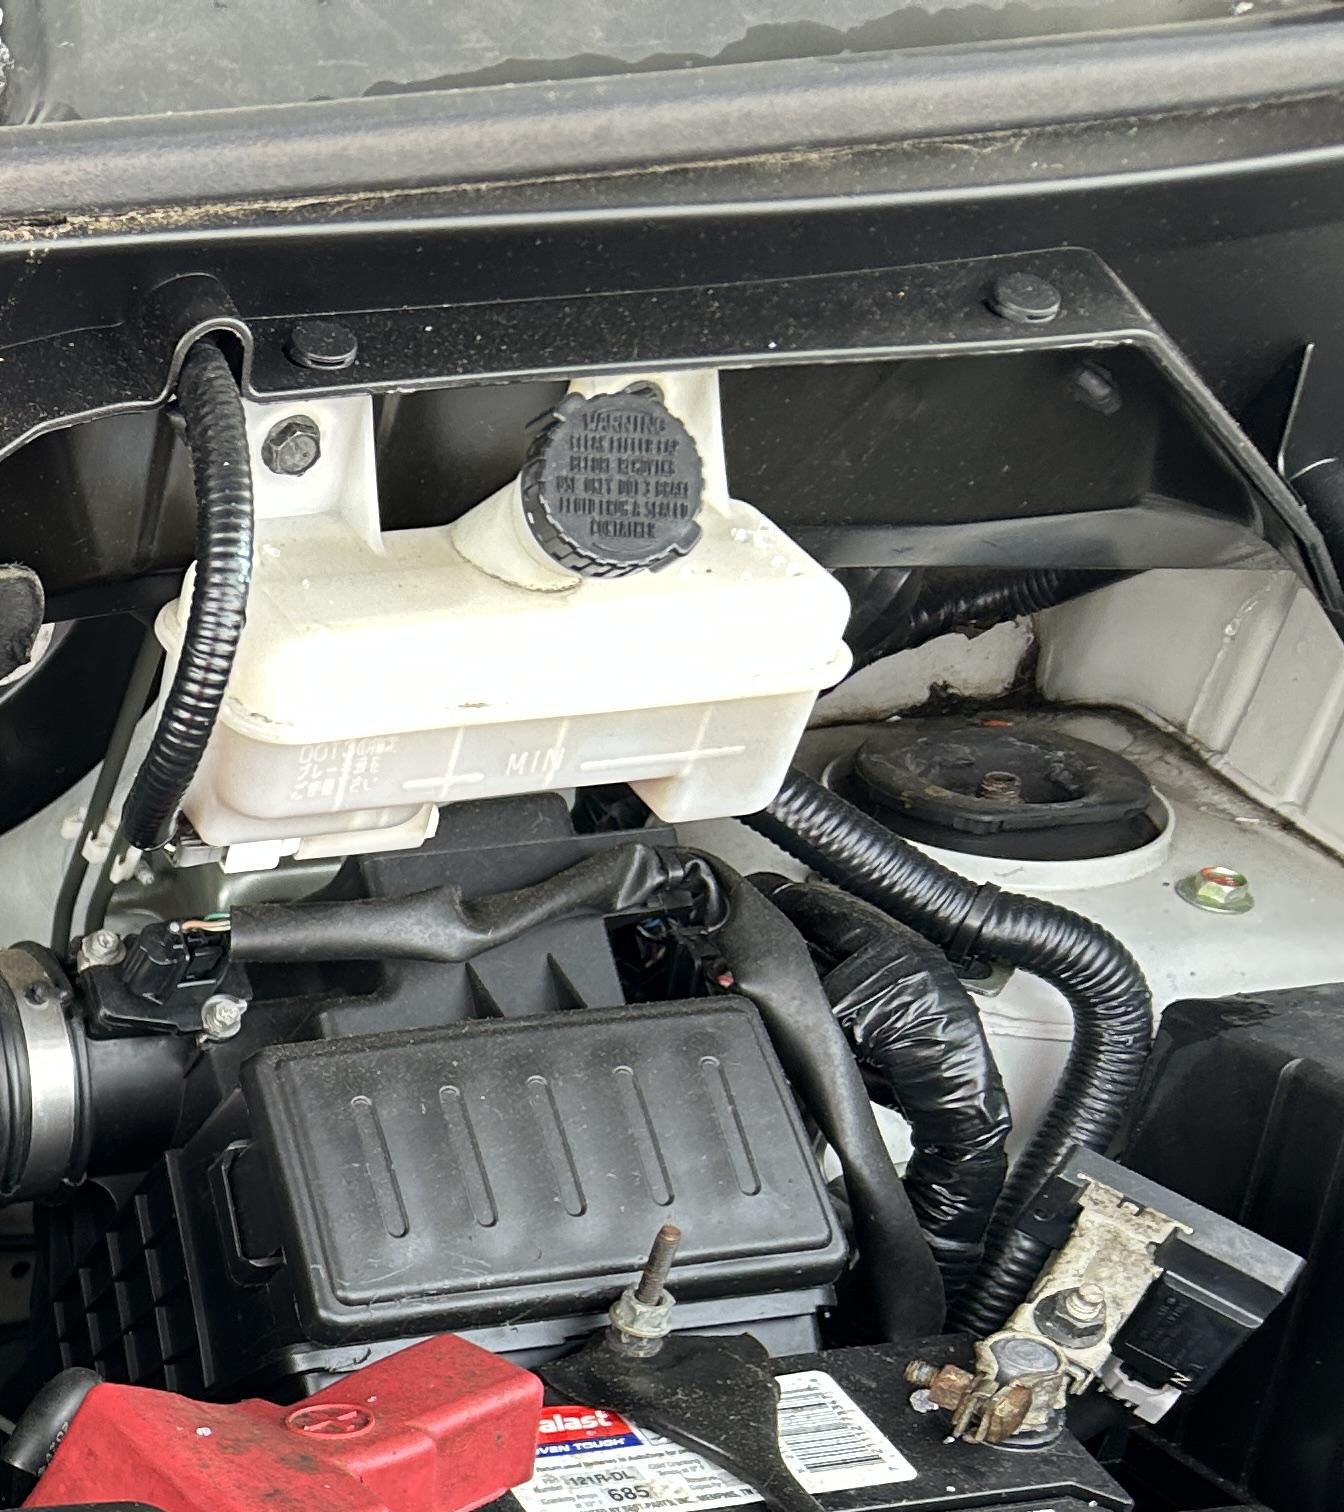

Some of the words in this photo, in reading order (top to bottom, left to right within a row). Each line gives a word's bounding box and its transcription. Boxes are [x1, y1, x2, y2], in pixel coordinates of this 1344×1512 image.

[505, 746, 566, 777] MIN
[539, 1409, 612, 1435] alast
[572, 1436, 627, 1452] TOUGH
[608, 1485, 651, 1502] 685
